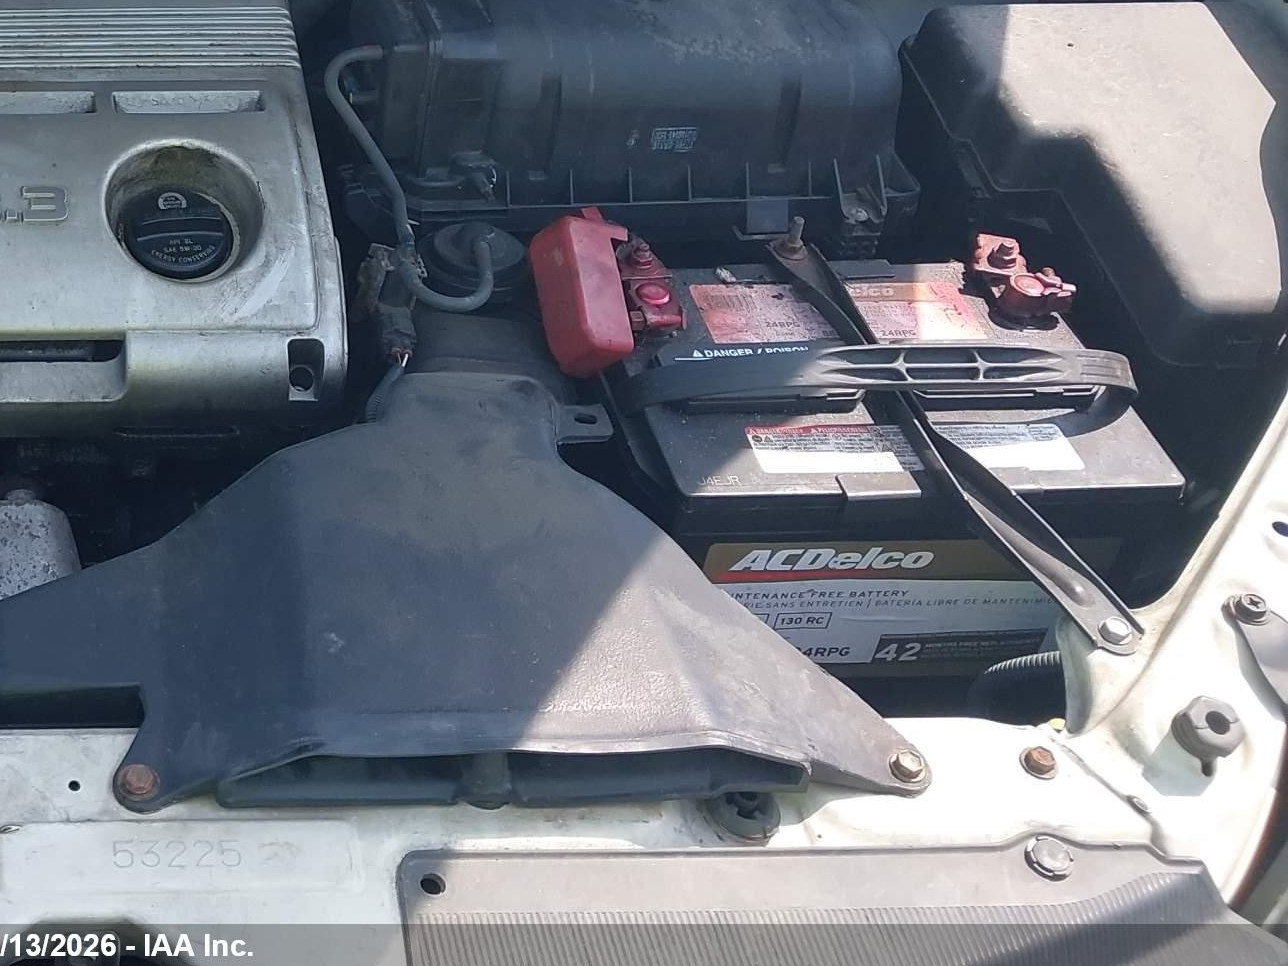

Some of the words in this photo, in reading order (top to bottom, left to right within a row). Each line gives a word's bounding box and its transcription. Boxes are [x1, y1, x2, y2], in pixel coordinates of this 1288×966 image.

[704, 348, 753, 358] DANGER
[729, 546, 936, 572] ACDelco
[812, 590, 844, 599] FREE
[850, 589, 909, 598] BATTERY
[766, 601, 795, 609] SANS
[800, 600, 863, 608] ENTRETIEN
[926, 598, 958, 606] LIBRE
[780, 617, 802, 625] 130
[806, 616, 825, 624] RC
[873, 642, 922, 662] 42
[112, 840, 242, 869] 53225
